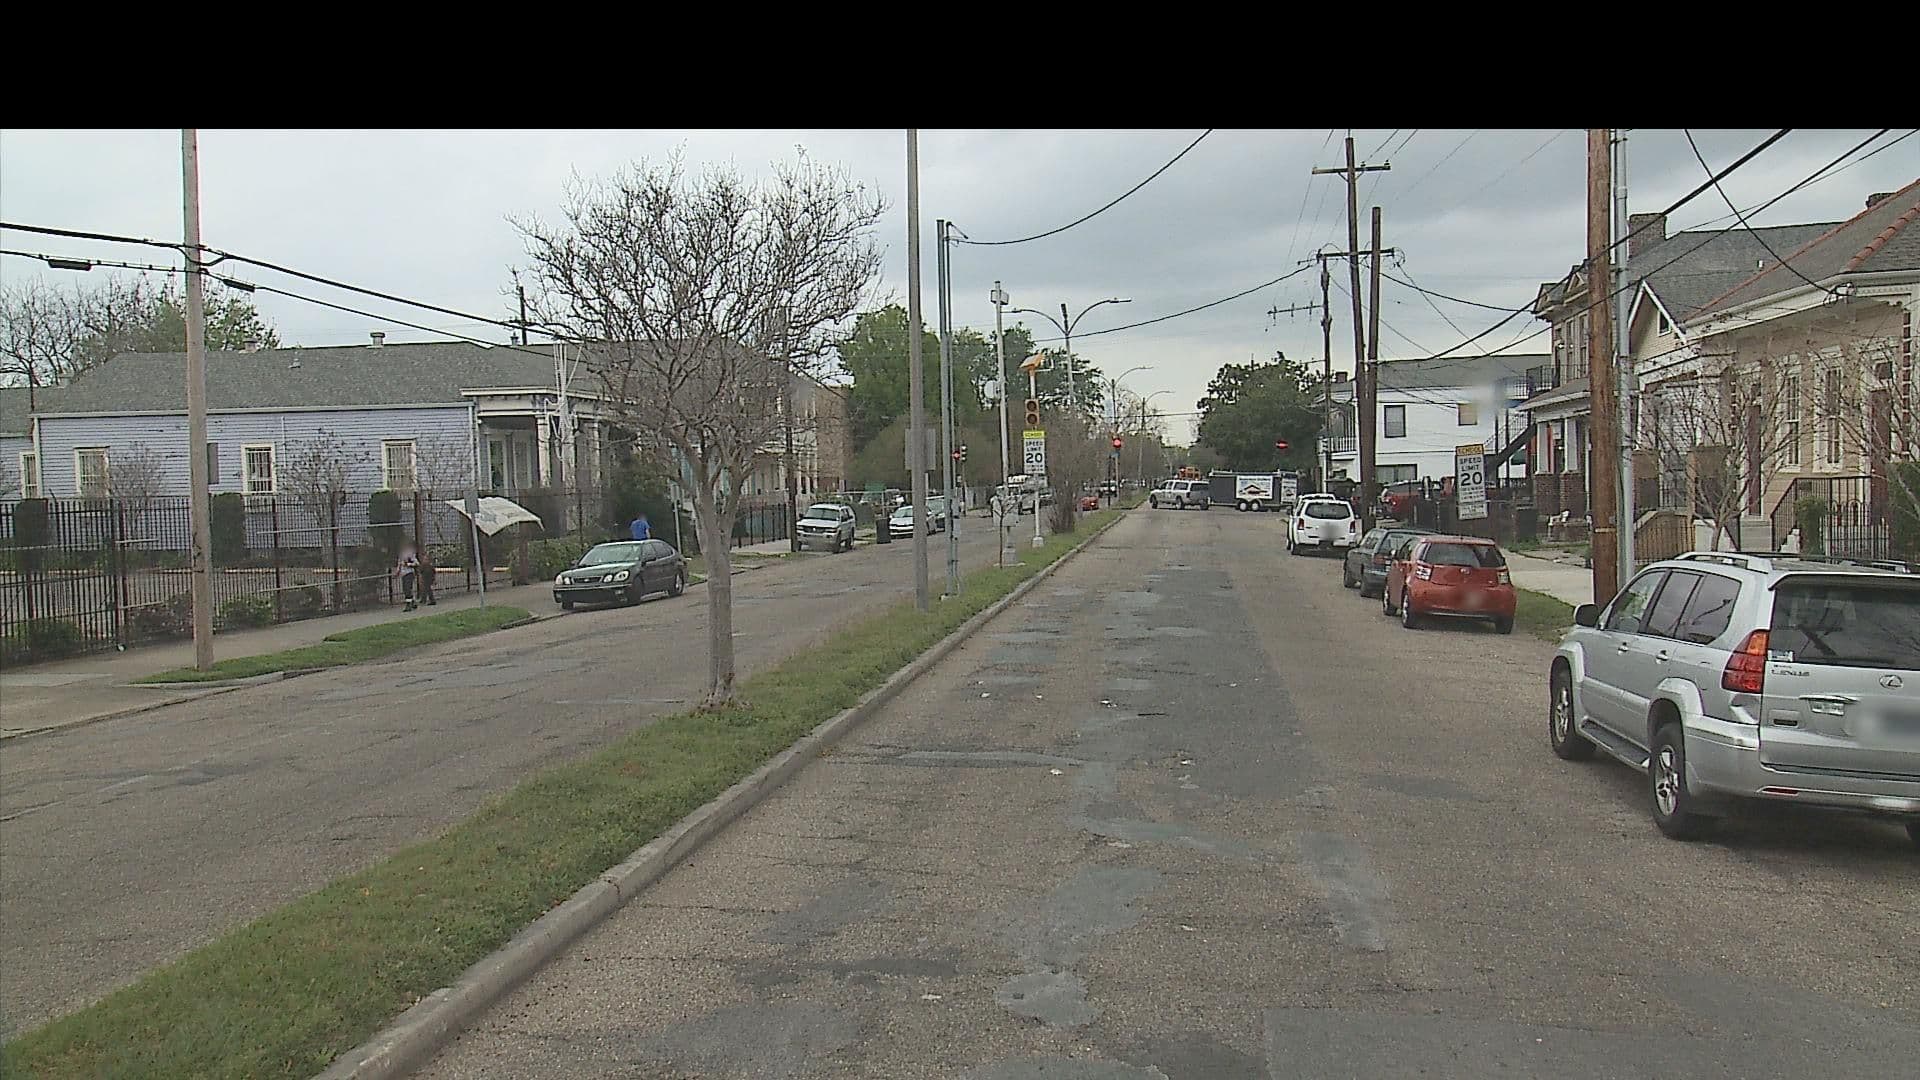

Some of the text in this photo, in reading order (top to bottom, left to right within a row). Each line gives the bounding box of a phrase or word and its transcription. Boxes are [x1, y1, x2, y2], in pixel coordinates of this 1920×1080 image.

[1025, 452, 1043, 464] 20
[1459, 457, 1482, 465] SPEED
[1460, 471, 1483, 486] 20
[1771, 669, 1810, 677] LEXUS
